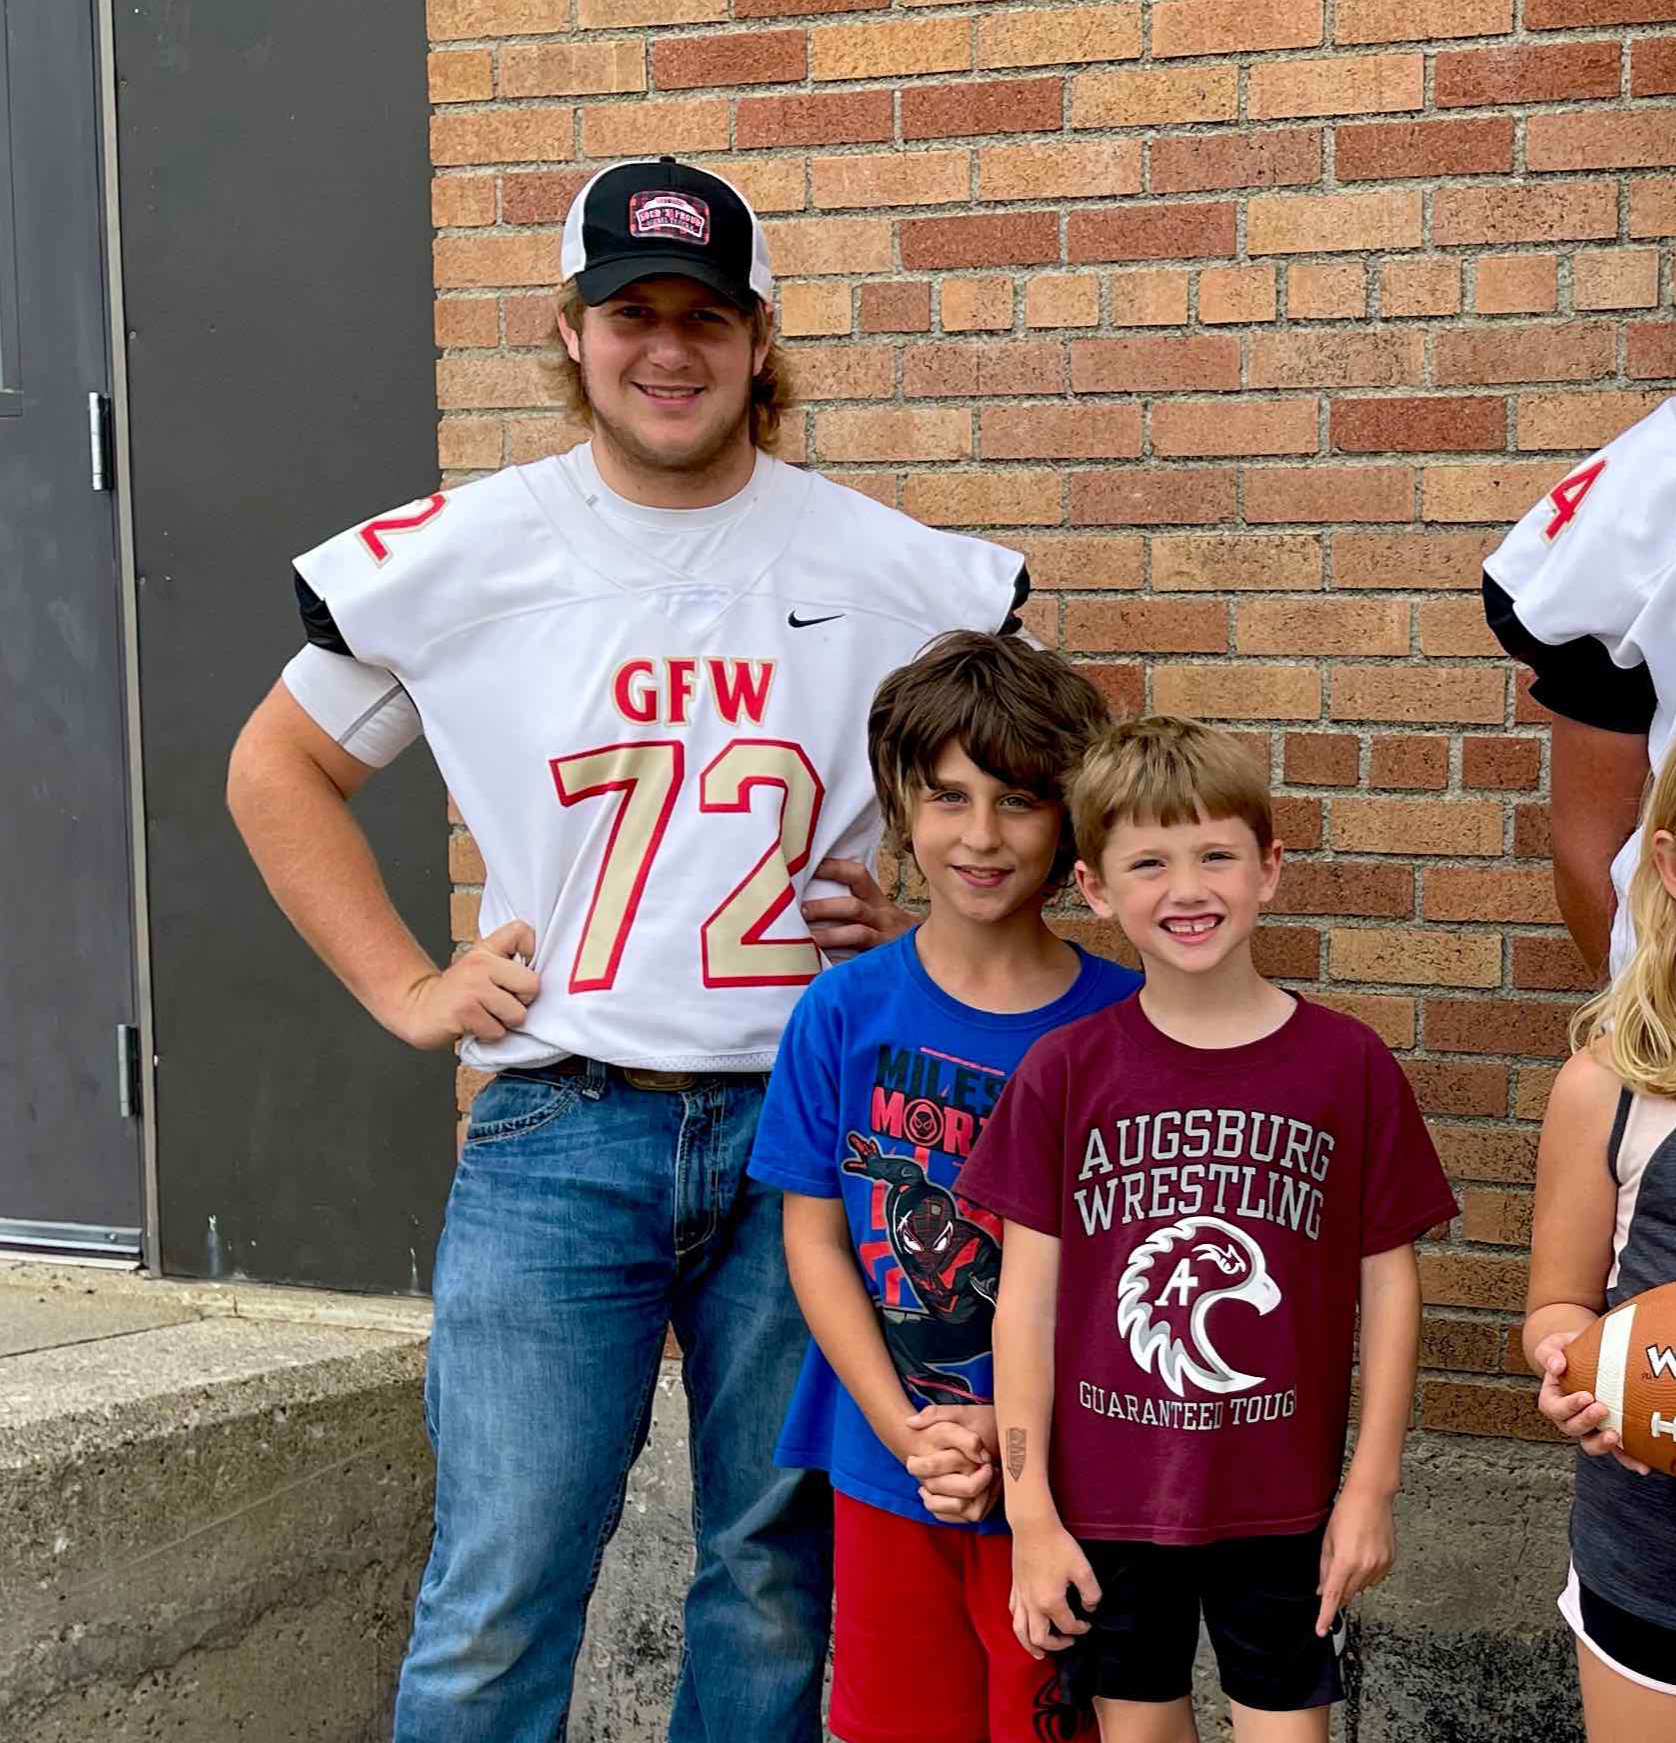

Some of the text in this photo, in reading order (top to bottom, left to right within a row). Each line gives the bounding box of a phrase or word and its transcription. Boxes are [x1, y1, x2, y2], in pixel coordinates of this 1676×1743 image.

[1541, 458, 1609, 546] 4
[612, 656, 777, 727] GFW
[548, 738, 825, 995] 72
[871, 1086, 990, 1158] MOR
[1078, 1108, 1335, 1183] AUGSBURG
[1073, 1163, 1325, 1241] WRESTLING
[1154, 1258, 1198, 1306] A
[1079, 1381, 1297, 1431] GUARANTEED TOUG
